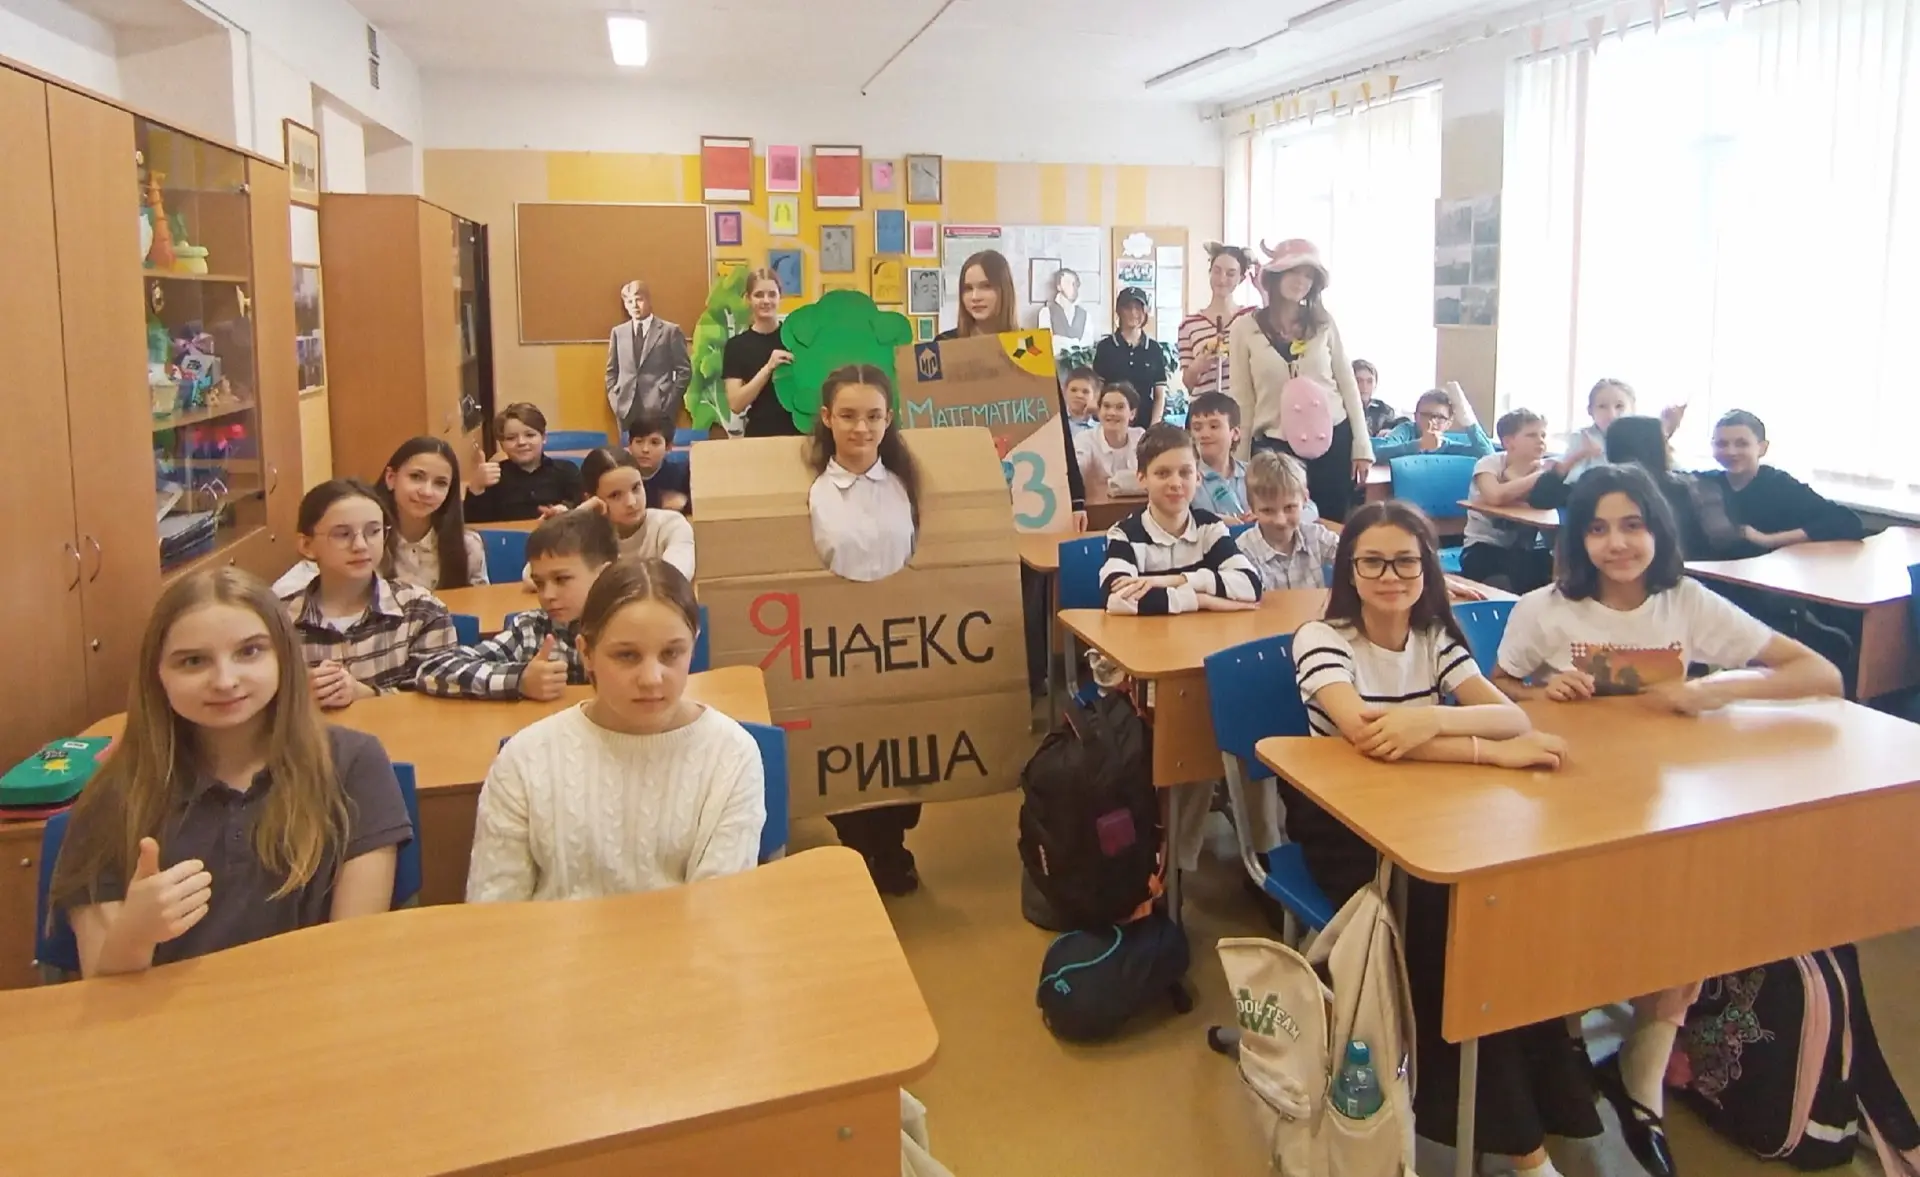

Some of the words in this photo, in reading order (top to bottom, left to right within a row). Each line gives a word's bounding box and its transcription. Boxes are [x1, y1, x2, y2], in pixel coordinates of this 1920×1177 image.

[1012, 451, 1057, 529] 3
[750, 592, 994, 680] ЯНДЕКС
[1265, 1003, 1301, 1041] TEAM
